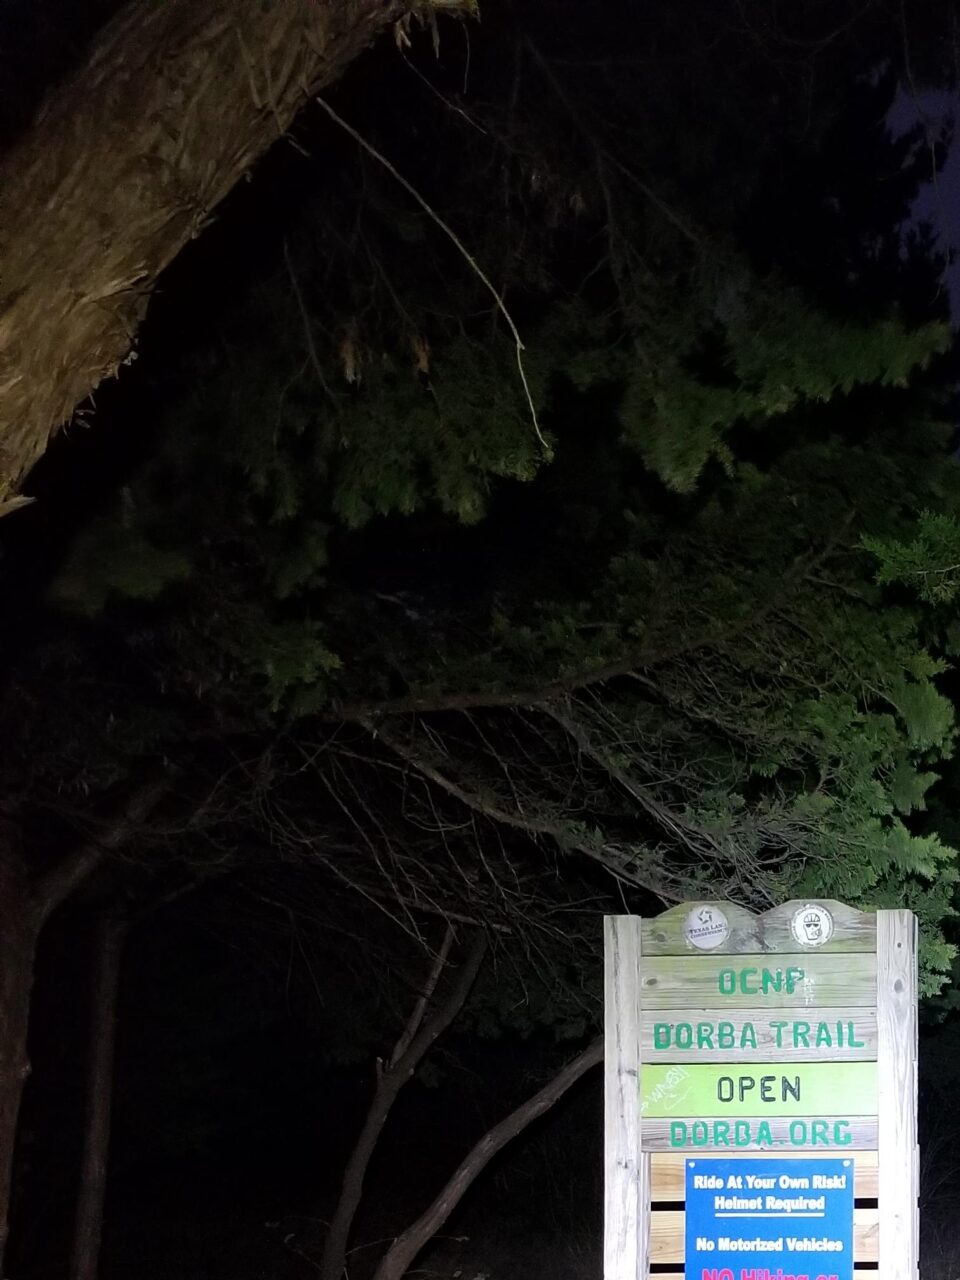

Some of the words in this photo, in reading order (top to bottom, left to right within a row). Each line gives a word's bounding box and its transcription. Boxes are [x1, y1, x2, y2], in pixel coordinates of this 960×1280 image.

[719, 967, 804, 994] OCNP
[653, 1021, 757, 1049] DORBA
[770, 1020, 864, 1048] TRAIL
[717, 1076, 800, 1102] OPEN
[670, 1120, 852, 1147] DORBA.ORG
[694, 1175, 724, 1189] Ride
[727, 1175, 743, 1189] At
[746, 1175, 776, 1189] Your
[779, 1175, 809, 1189] Own
[812, 1175, 847, 1189] Risk!
[714, 1196, 763, 1210] Helmet
[766, 1196, 825, 1212] Required
[696, 1238, 714, 1251] No
[718, 1238, 783, 1251] Motorized
[786, 1238, 844, 1251] Vehicles
